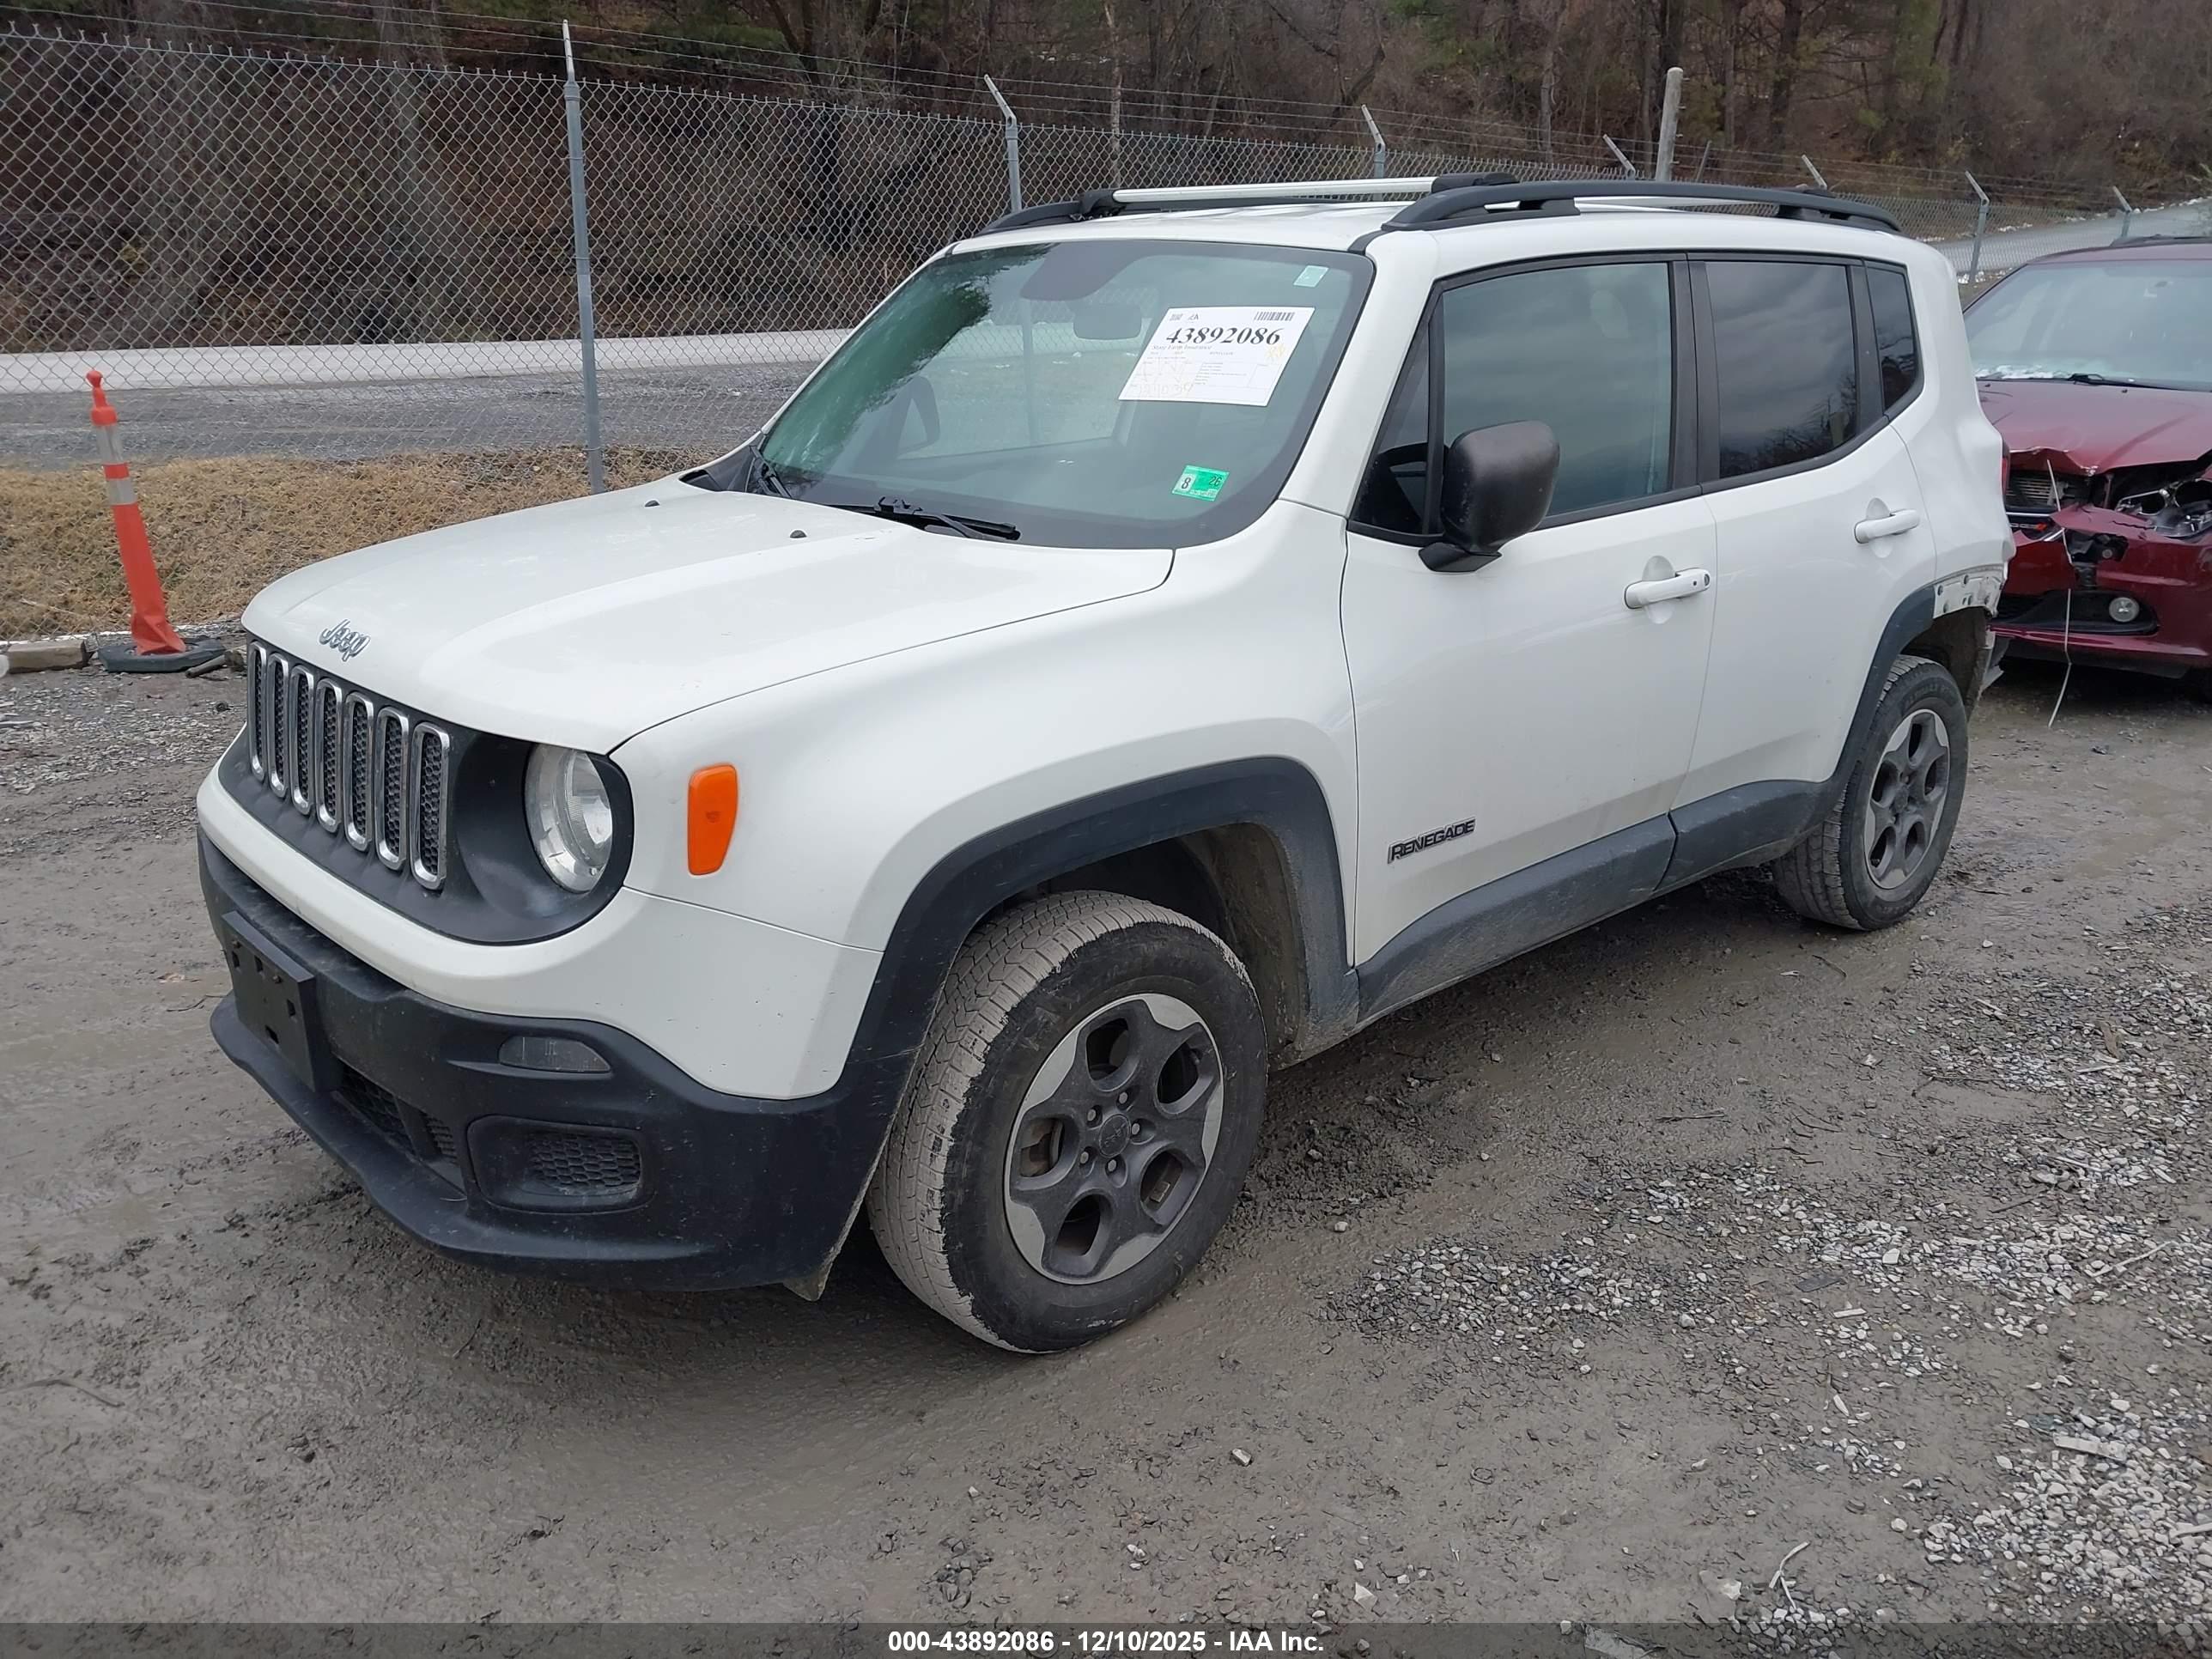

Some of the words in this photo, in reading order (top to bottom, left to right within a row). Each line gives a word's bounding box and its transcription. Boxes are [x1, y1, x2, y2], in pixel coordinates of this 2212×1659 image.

[1165, 326, 1285, 345] 43892086
[1181, 477, 1192, 489] 8
[319, 618, 371, 662] Jeep
[1388, 817, 1476, 864] RENEGADE
